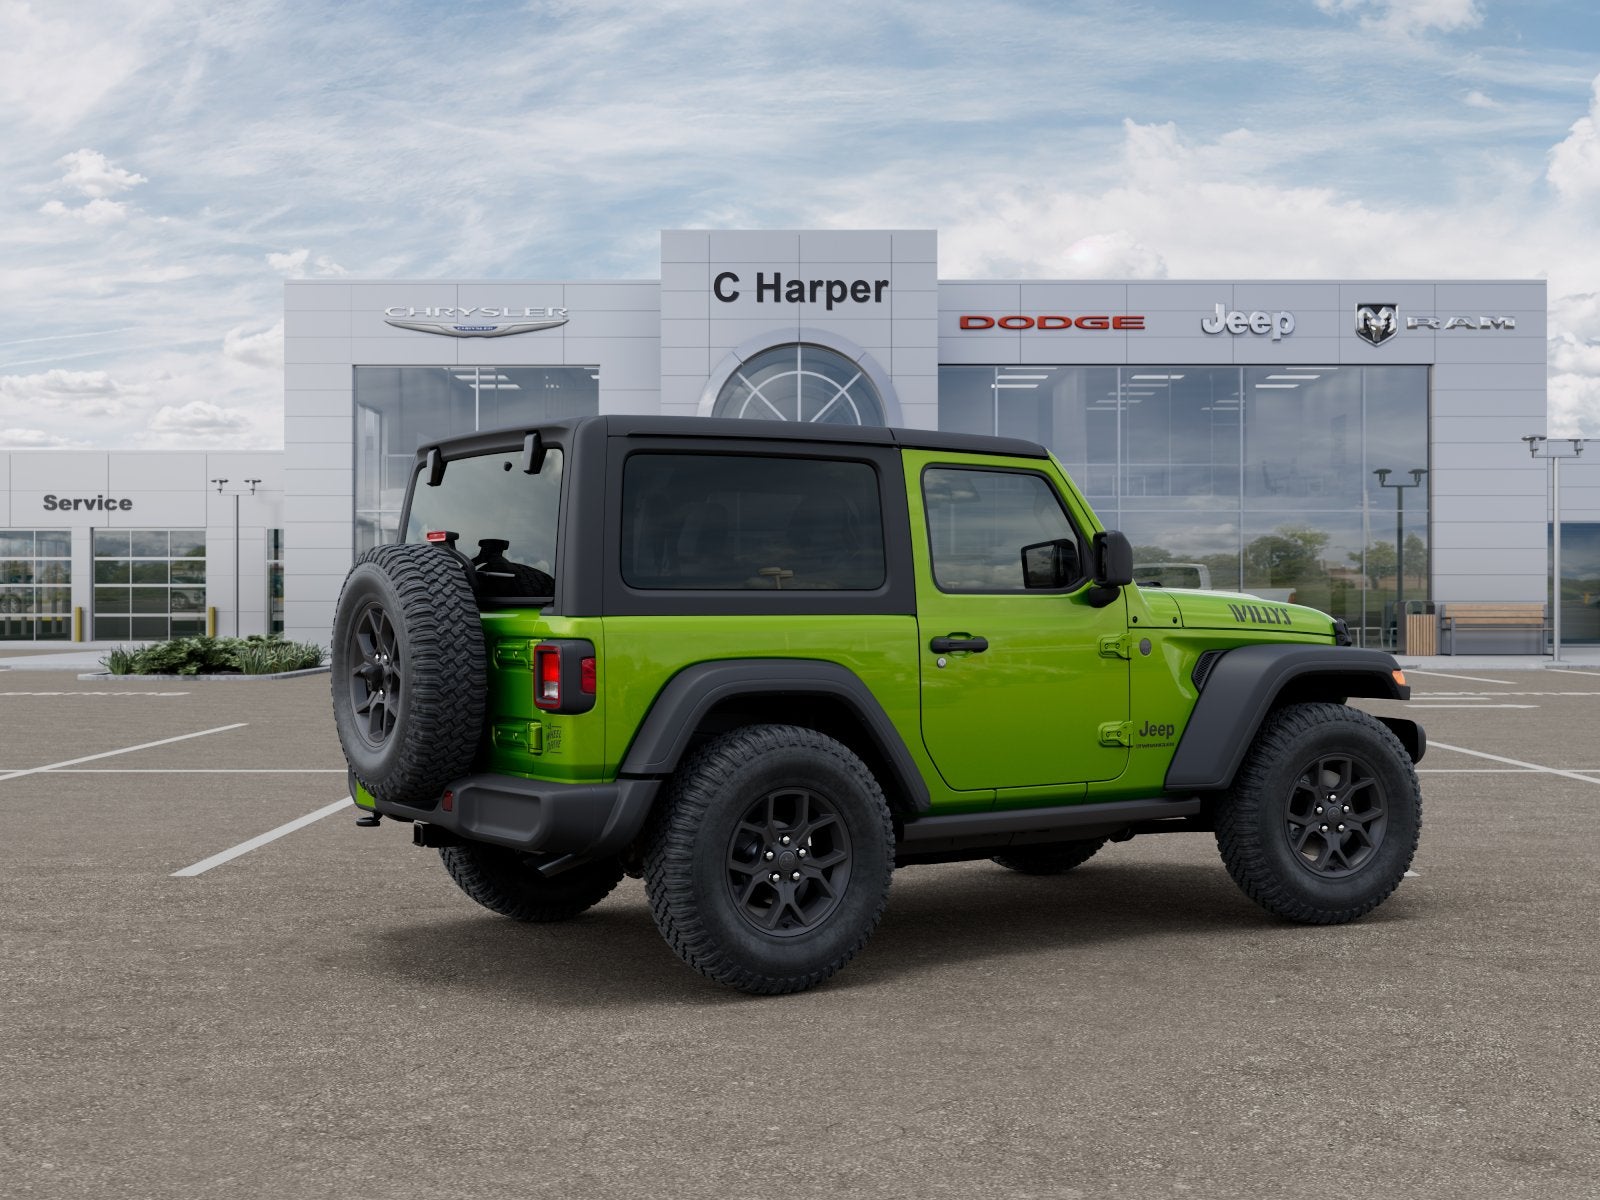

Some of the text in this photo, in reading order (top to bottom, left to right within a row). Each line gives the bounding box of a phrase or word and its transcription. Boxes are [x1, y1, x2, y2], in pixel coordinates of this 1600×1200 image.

[713, 271, 889, 311] C Harper
[384, 306, 569, 318] CHRYSLER
[959, 315, 1146, 331] DODGE
[1201, 303, 1295, 341] Jeep
[1406, 316, 1515, 330] RAM
[43, 494, 133, 511] Service
[1227, 603, 1292, 625] WILLYS
[1139, 720, 1175, 739] Jeep
